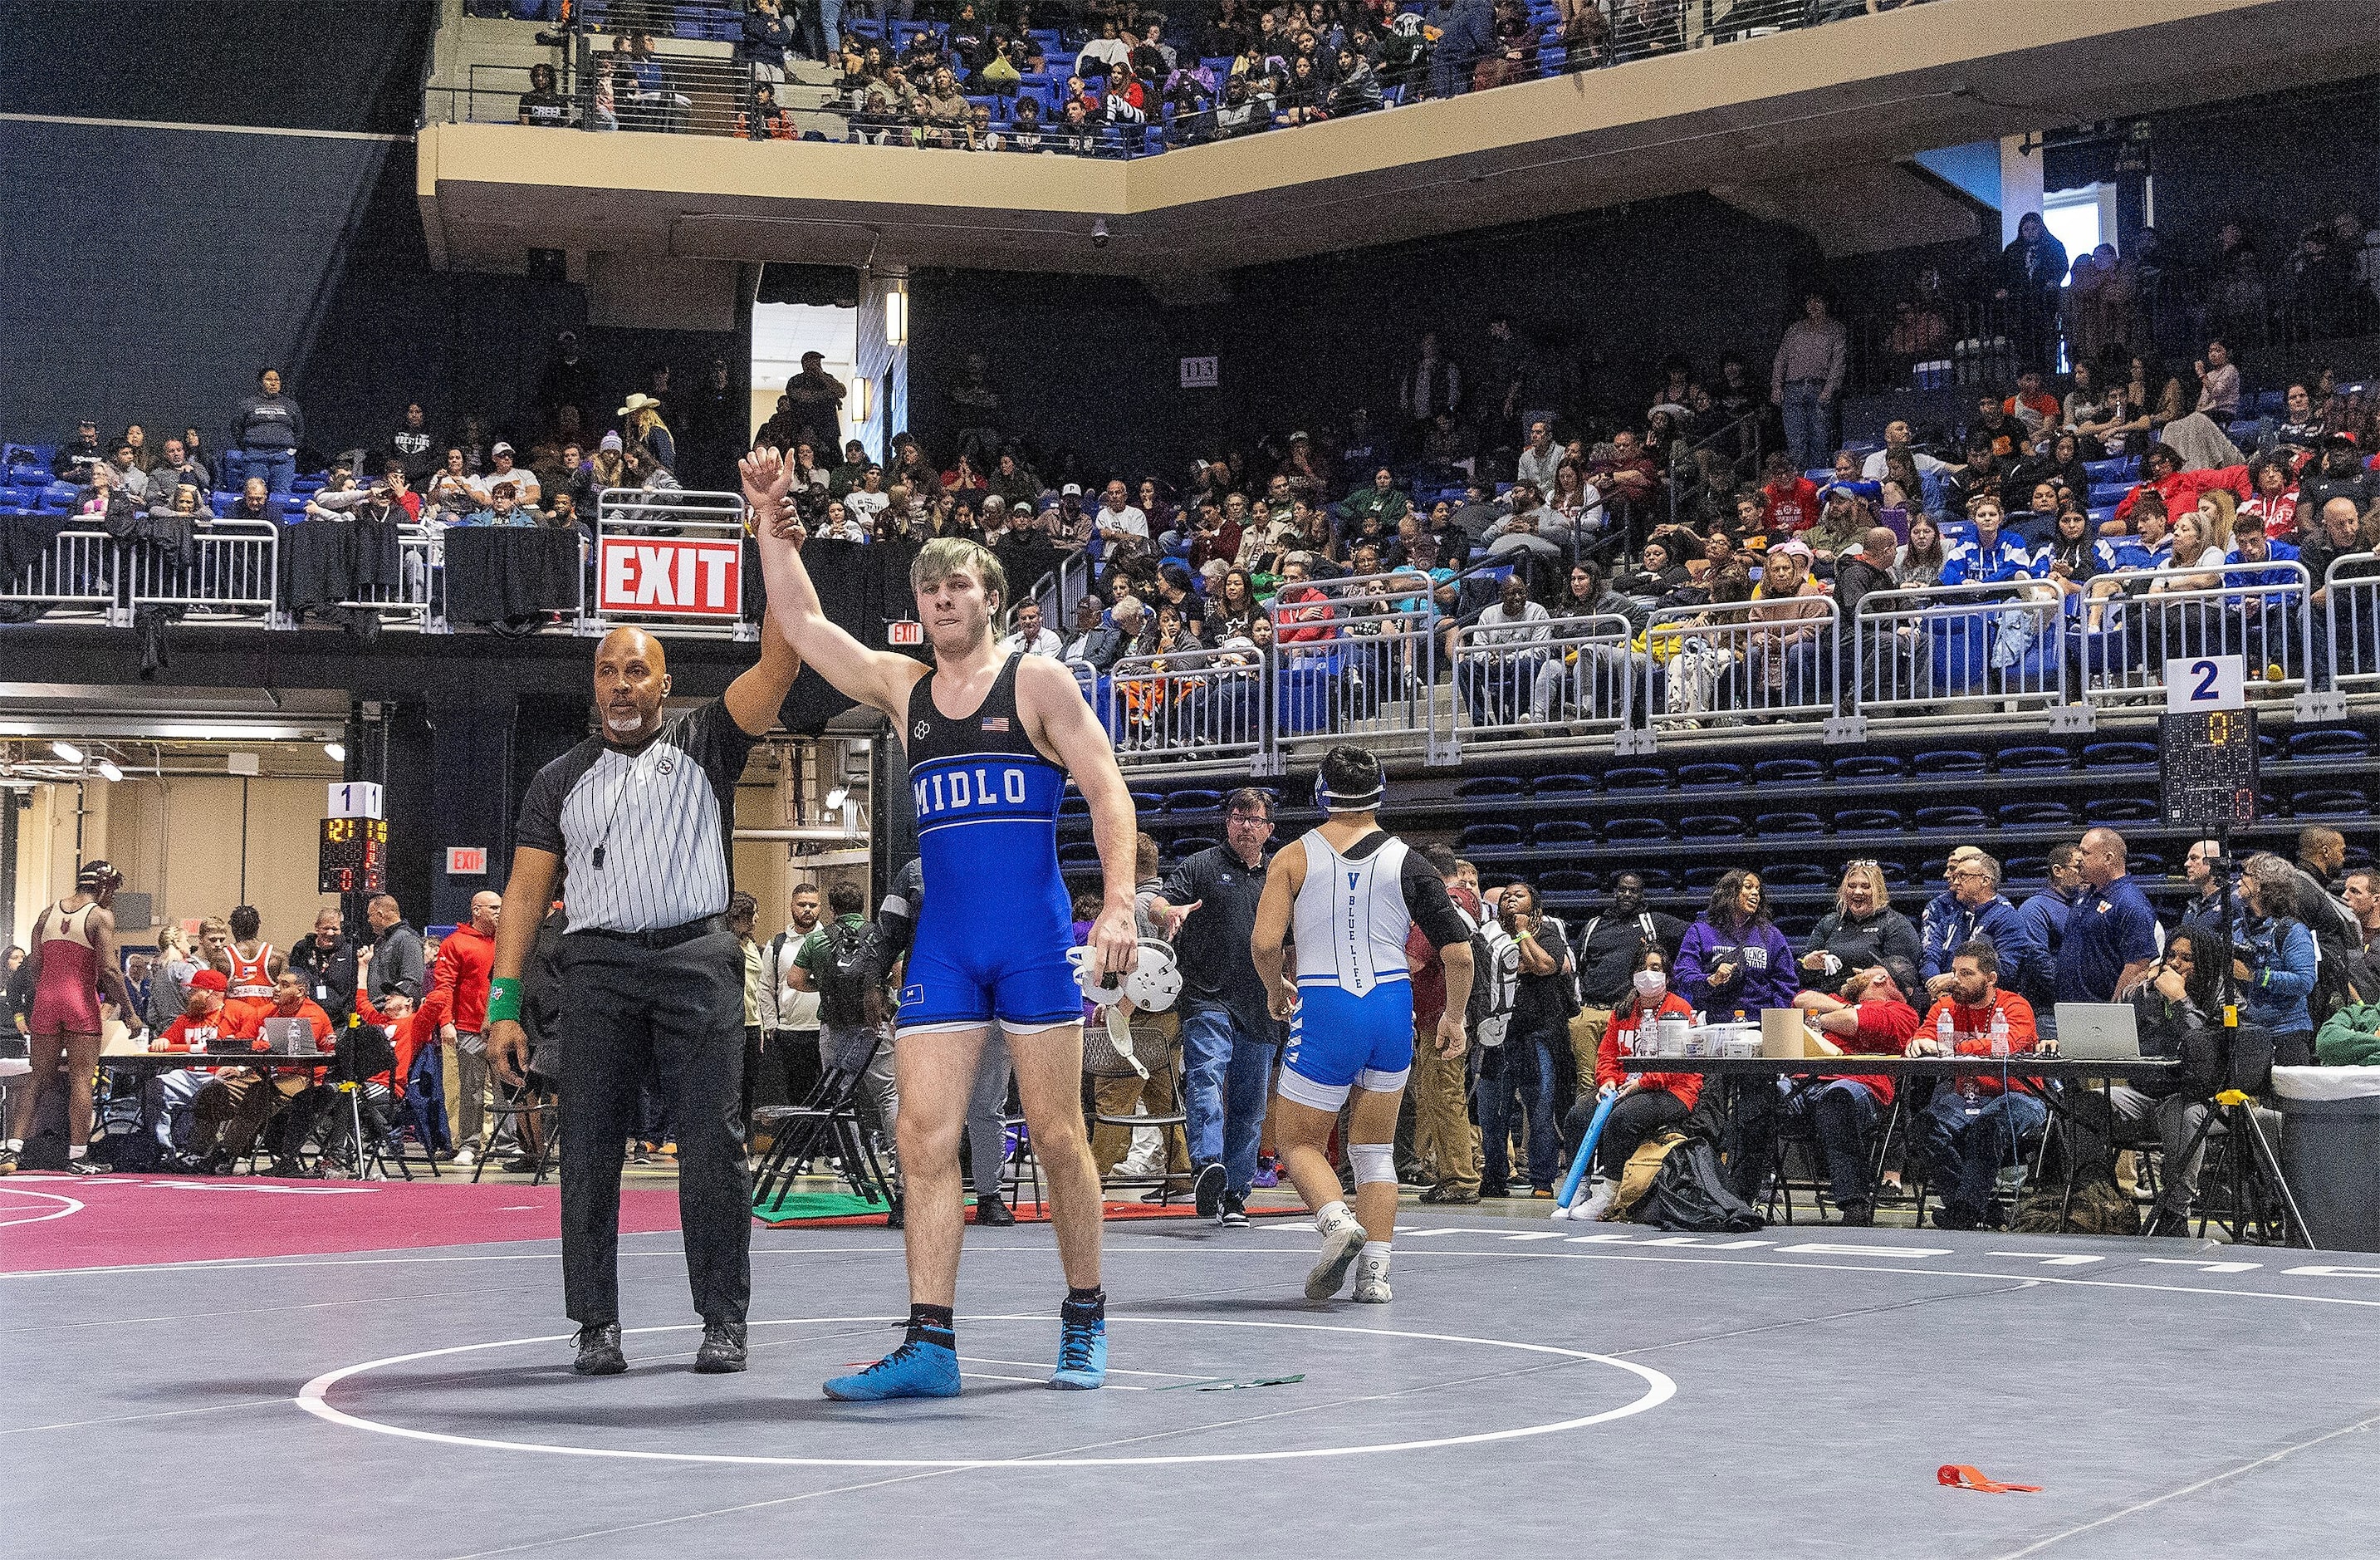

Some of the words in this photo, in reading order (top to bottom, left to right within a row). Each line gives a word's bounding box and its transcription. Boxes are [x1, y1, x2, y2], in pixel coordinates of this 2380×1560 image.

[1186, 361, 1213, 376] 113
[605, 545, 736, 608] EXIT
[894, 624, 918, 642] EXIT
[2190, 660, 2219, 701] 2
[341, 784, 350, 812] 1
[372, 786, 377, 812] 1
[914, 768, 1026, 818] MIDLO
[2236, 787, 2253, 819] 0
[454, 851, 481, 870] EXIT
[1348, 872, 1360, 890] V
[1350, 945, 1362, 988] LIFE
